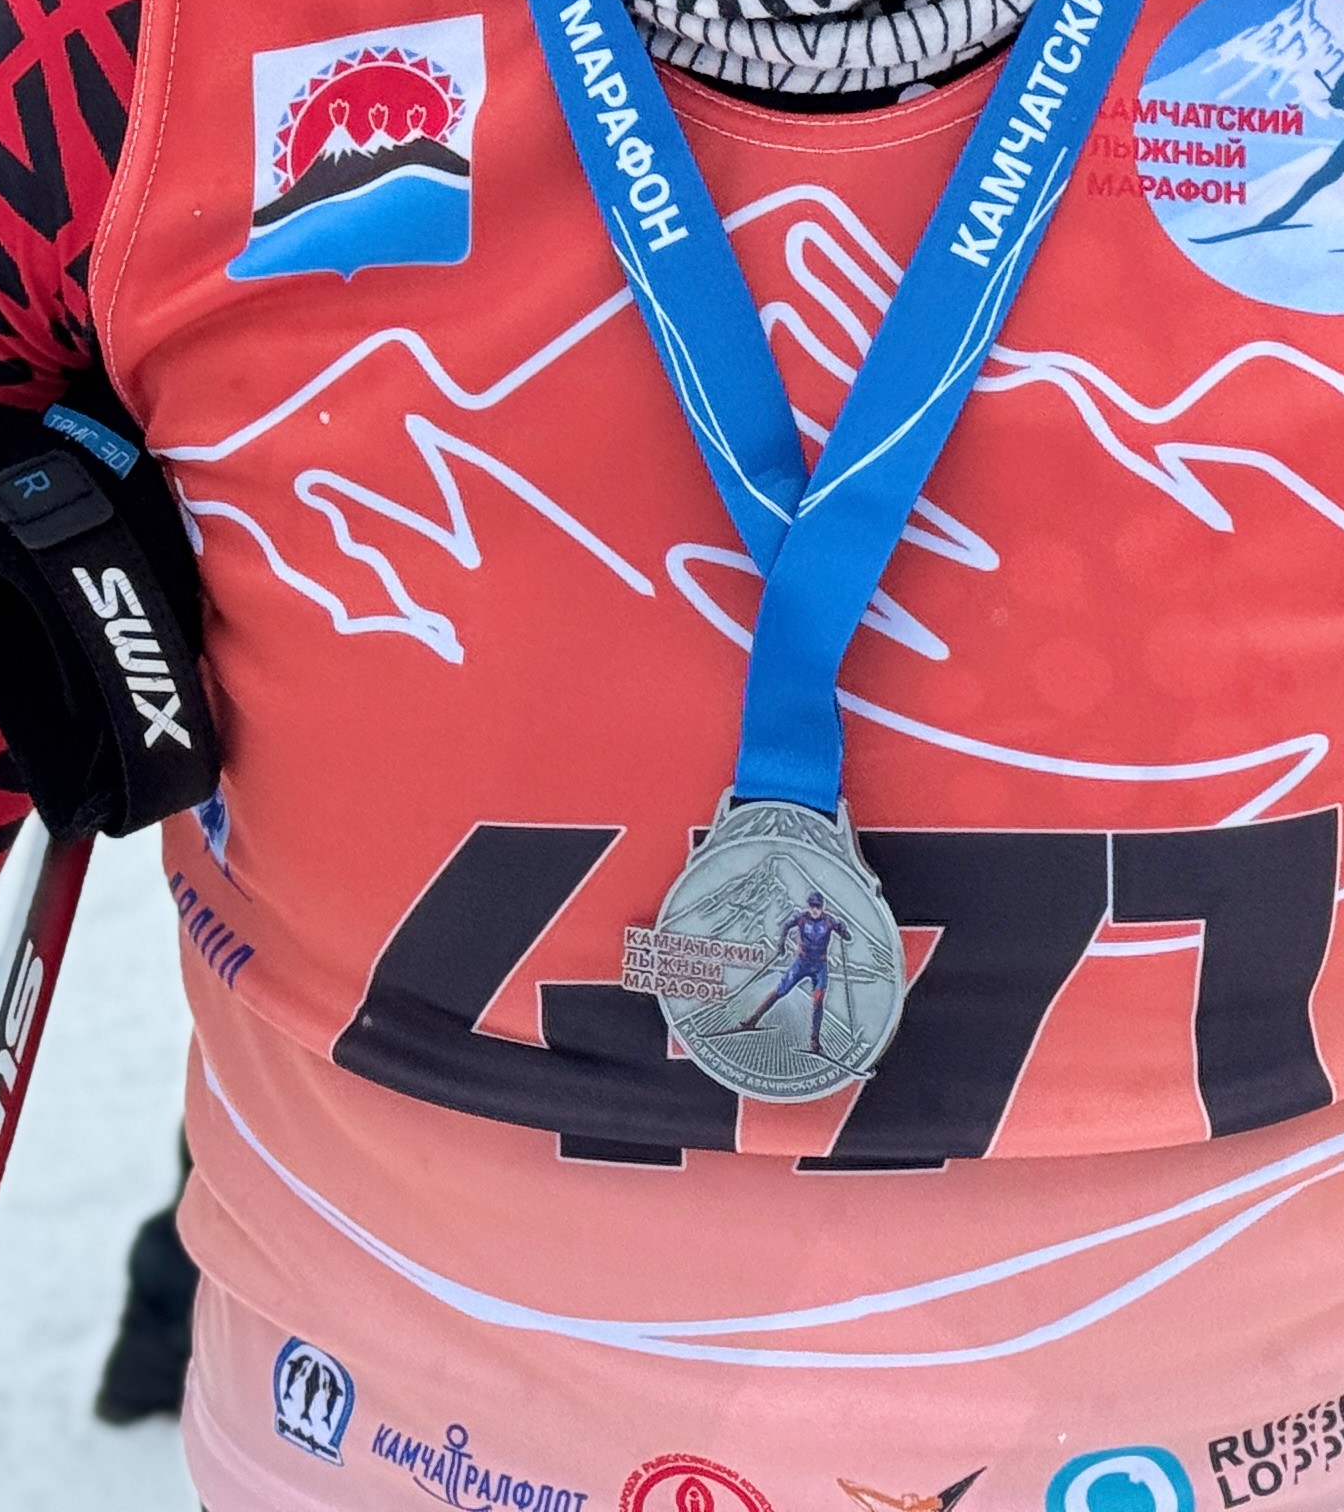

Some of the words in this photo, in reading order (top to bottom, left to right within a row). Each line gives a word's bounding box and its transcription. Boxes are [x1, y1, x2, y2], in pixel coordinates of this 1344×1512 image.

[1088, 135, 1246, 169] ЛЫЖНЫЙ
[1086, 172, 1246, 205] МАРАФОН
[13, 469, 51, 500] R
[71, 566, 192, 749] SWIX
[622, 971, 726, 999] МАРАФОН
